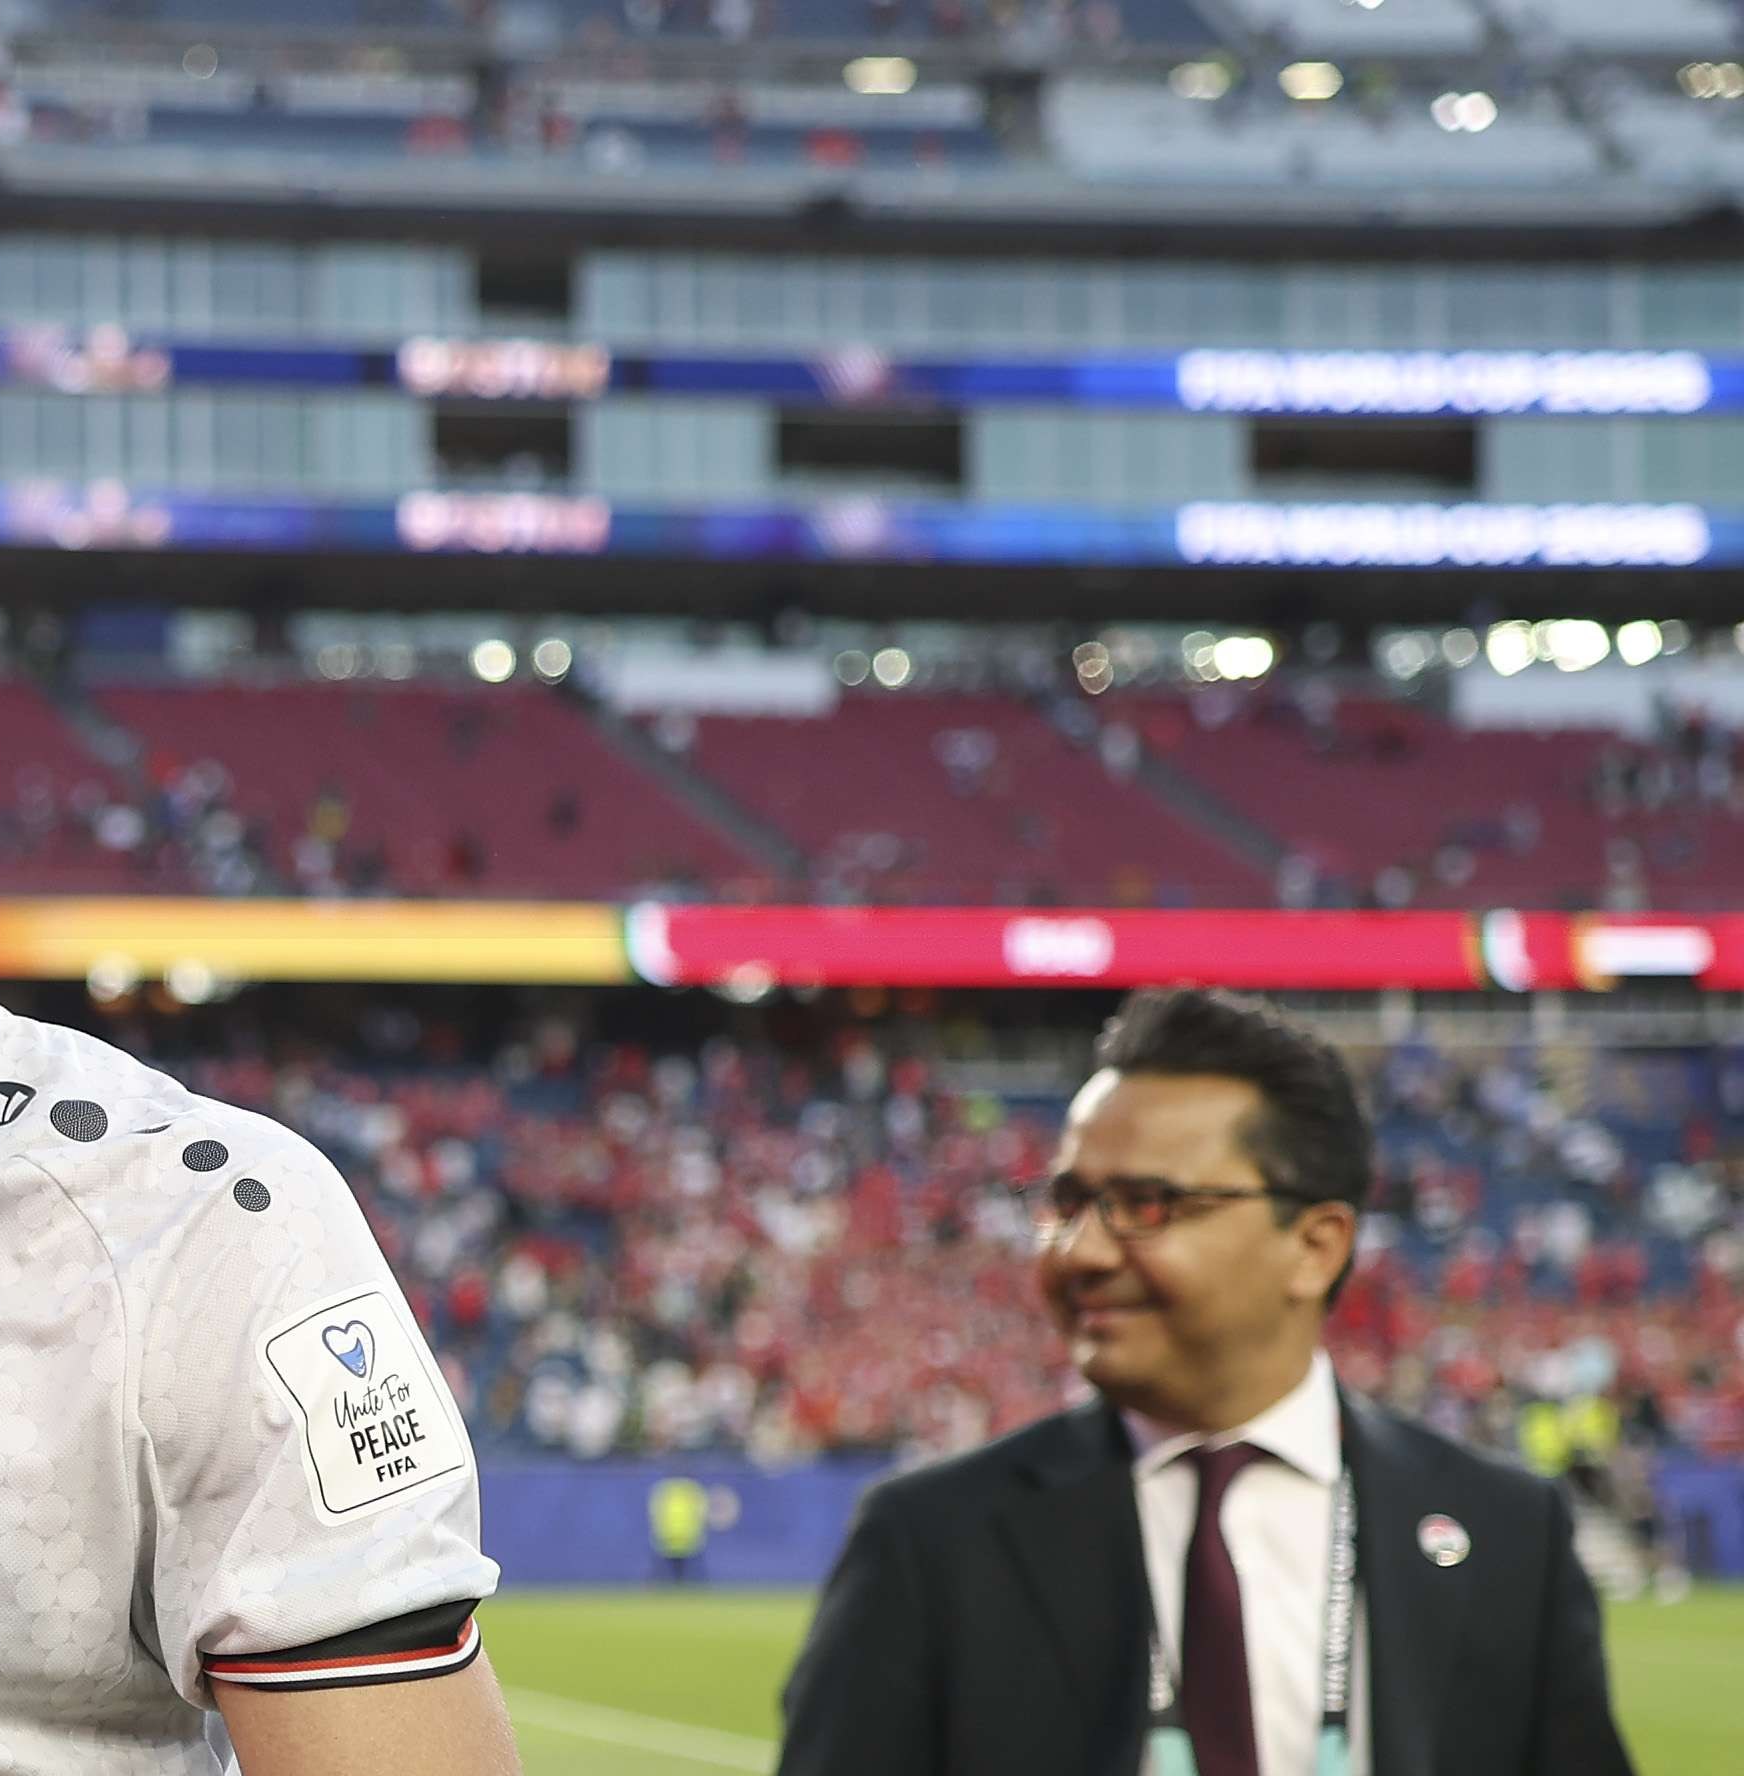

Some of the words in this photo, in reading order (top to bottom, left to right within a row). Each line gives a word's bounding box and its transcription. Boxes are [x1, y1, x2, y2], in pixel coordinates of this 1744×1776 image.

[334, 1386, 383, 1429] Unite
[380, 1374, 411, 1410] For
[350, 1409, 426, 1465] PEACE
[376, 1456, 417, 1482] FIFA
